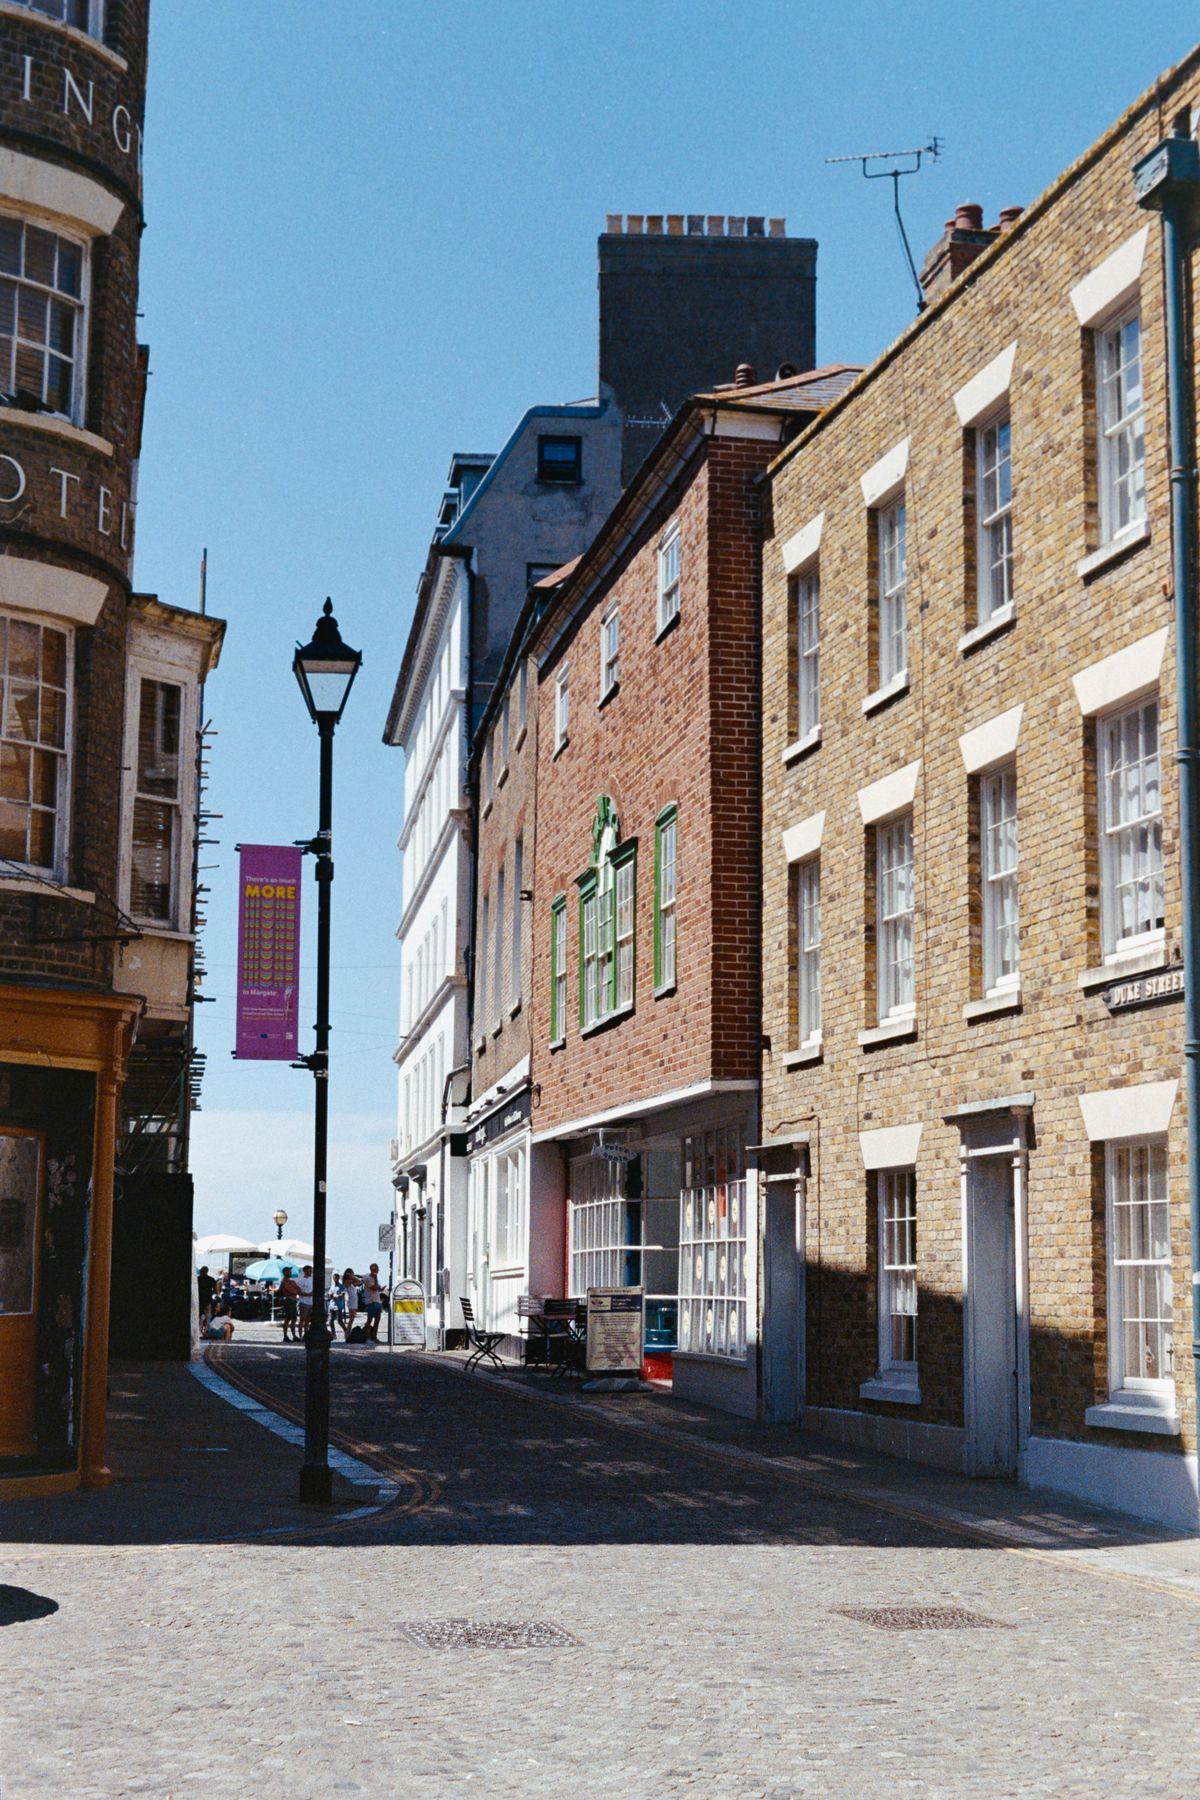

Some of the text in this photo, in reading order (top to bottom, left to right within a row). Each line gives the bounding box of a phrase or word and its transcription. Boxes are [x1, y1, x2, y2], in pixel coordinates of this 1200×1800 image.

[244, 884, 296, 899] MORE
[250, 989, 277, 998] Margate
[1114, 972, 1184, 1005] DUKE STREET
